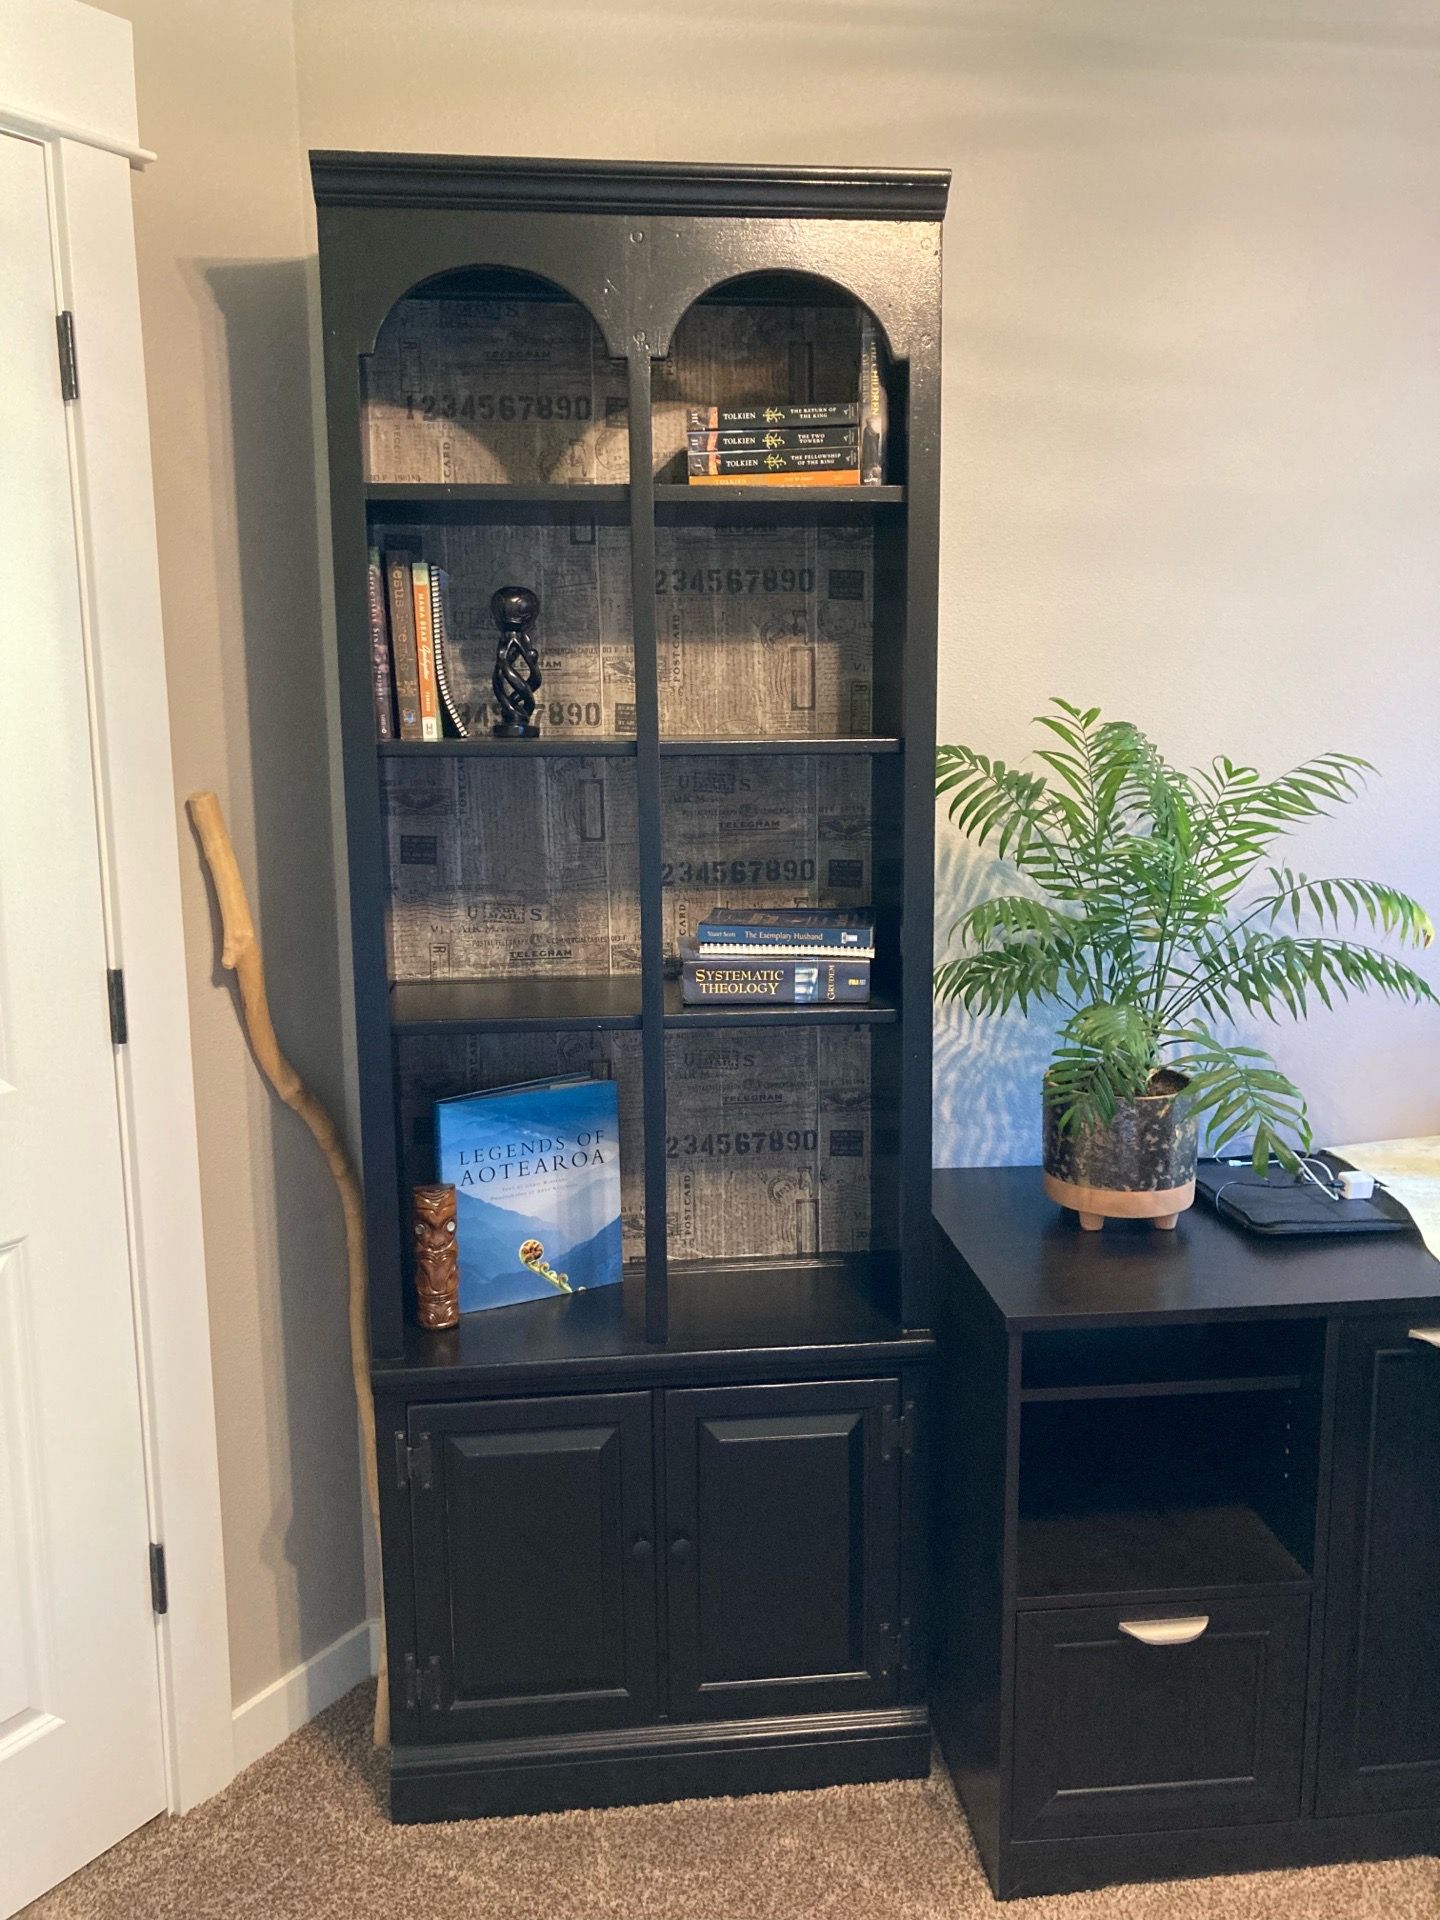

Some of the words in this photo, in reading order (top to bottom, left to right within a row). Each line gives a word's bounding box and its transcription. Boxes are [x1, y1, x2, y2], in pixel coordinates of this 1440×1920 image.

[871, 364, 880, 416] CHILDREN
[405, 394, 592, 421] 1234567890
[723, 412, 756, 421] TOLKIEN
[726, 459, 759, 467] TOLKIEN
[418, 593, 426, 618] MAMA
[745, 931, 757, 939] The
[759, 931, 792, 941] Exemplary
[794, 933, 824, 941] Husband
[509, 950, 572, 958] TELEGRAM
[695, 969, 785, 982] SYSTEMATIC
[827, 965, 835, 1000] GRUDEM
[700, 983, 779, 995] THEOLOGY
[460, 1137, 565, 1166] LEGENDS
[577, 1130, 605, 1147] OF
[461, 1149, 606, 1187] AOTEAROA
